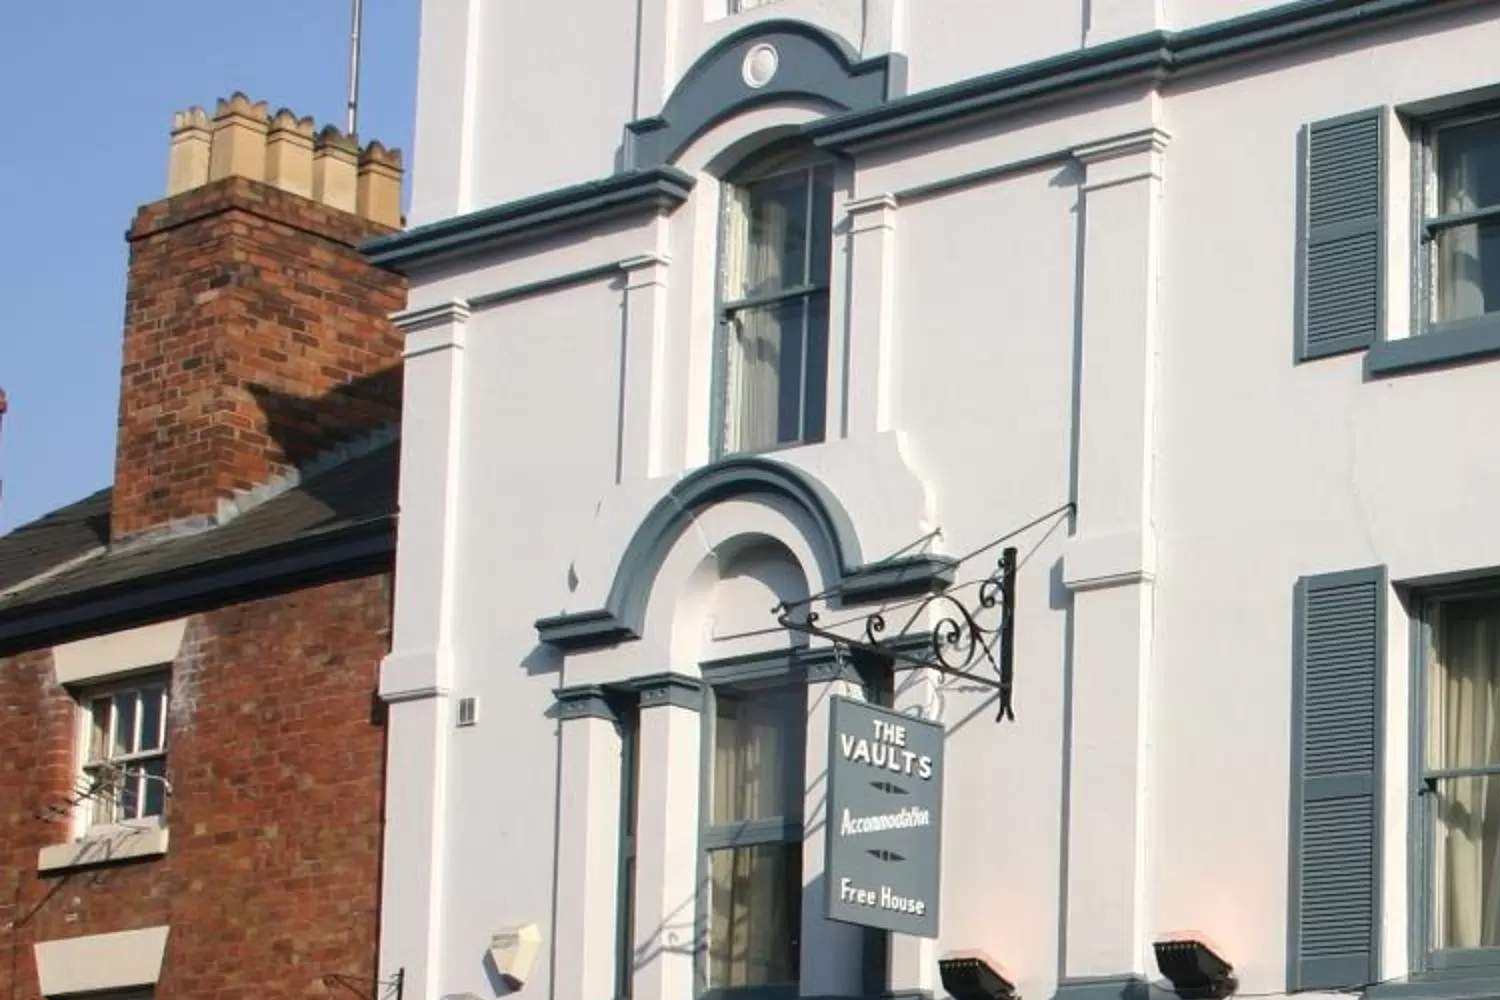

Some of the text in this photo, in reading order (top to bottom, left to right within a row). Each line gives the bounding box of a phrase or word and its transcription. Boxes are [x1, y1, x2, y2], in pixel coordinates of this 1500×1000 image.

[873, 720, 906, 745] THE
[841, 733, 932, 778] VAULTS
[841, 806, 930, 836] Accommodation
[841, 878, 925, 914] Free House
